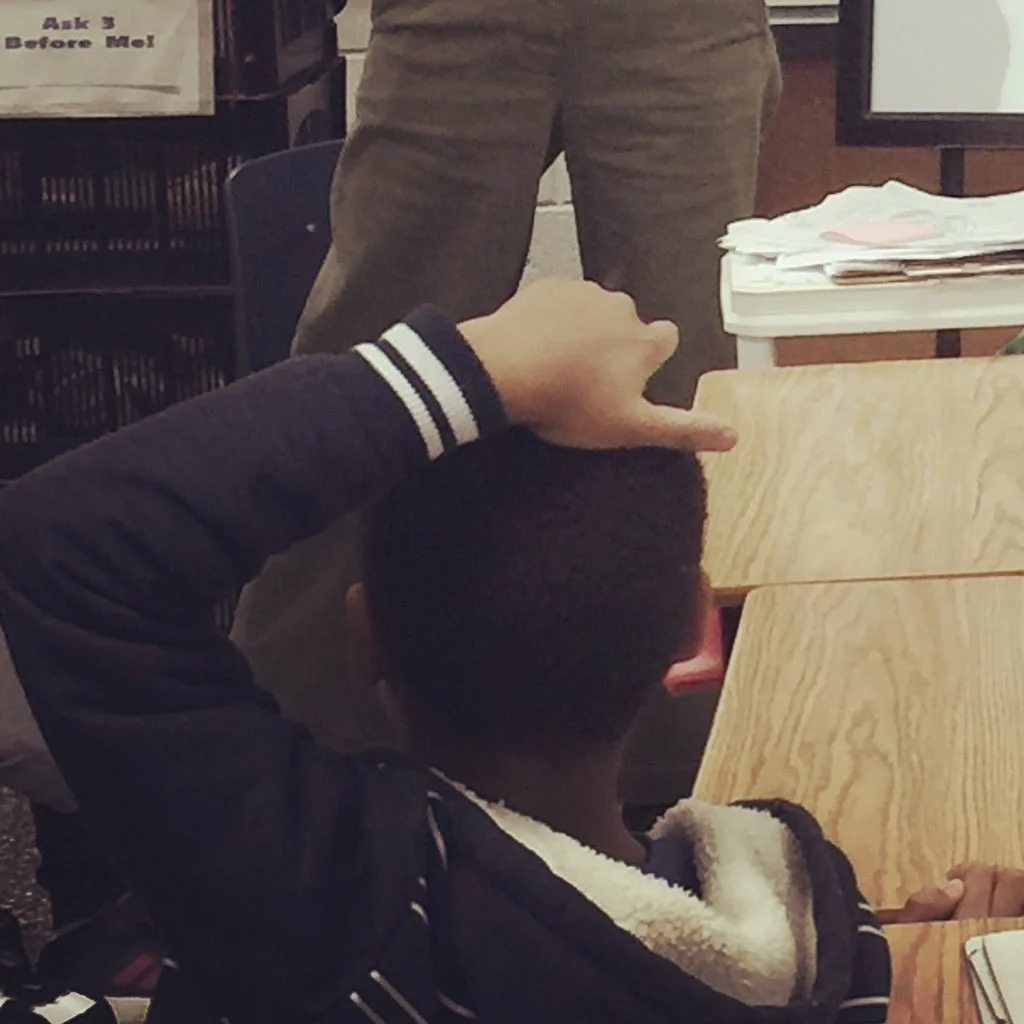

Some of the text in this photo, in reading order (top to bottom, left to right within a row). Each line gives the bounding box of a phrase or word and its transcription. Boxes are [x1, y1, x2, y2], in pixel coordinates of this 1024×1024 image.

[42, 16, 116, 31] Ask 3
[4, 34, 155, 50] Before Me!
